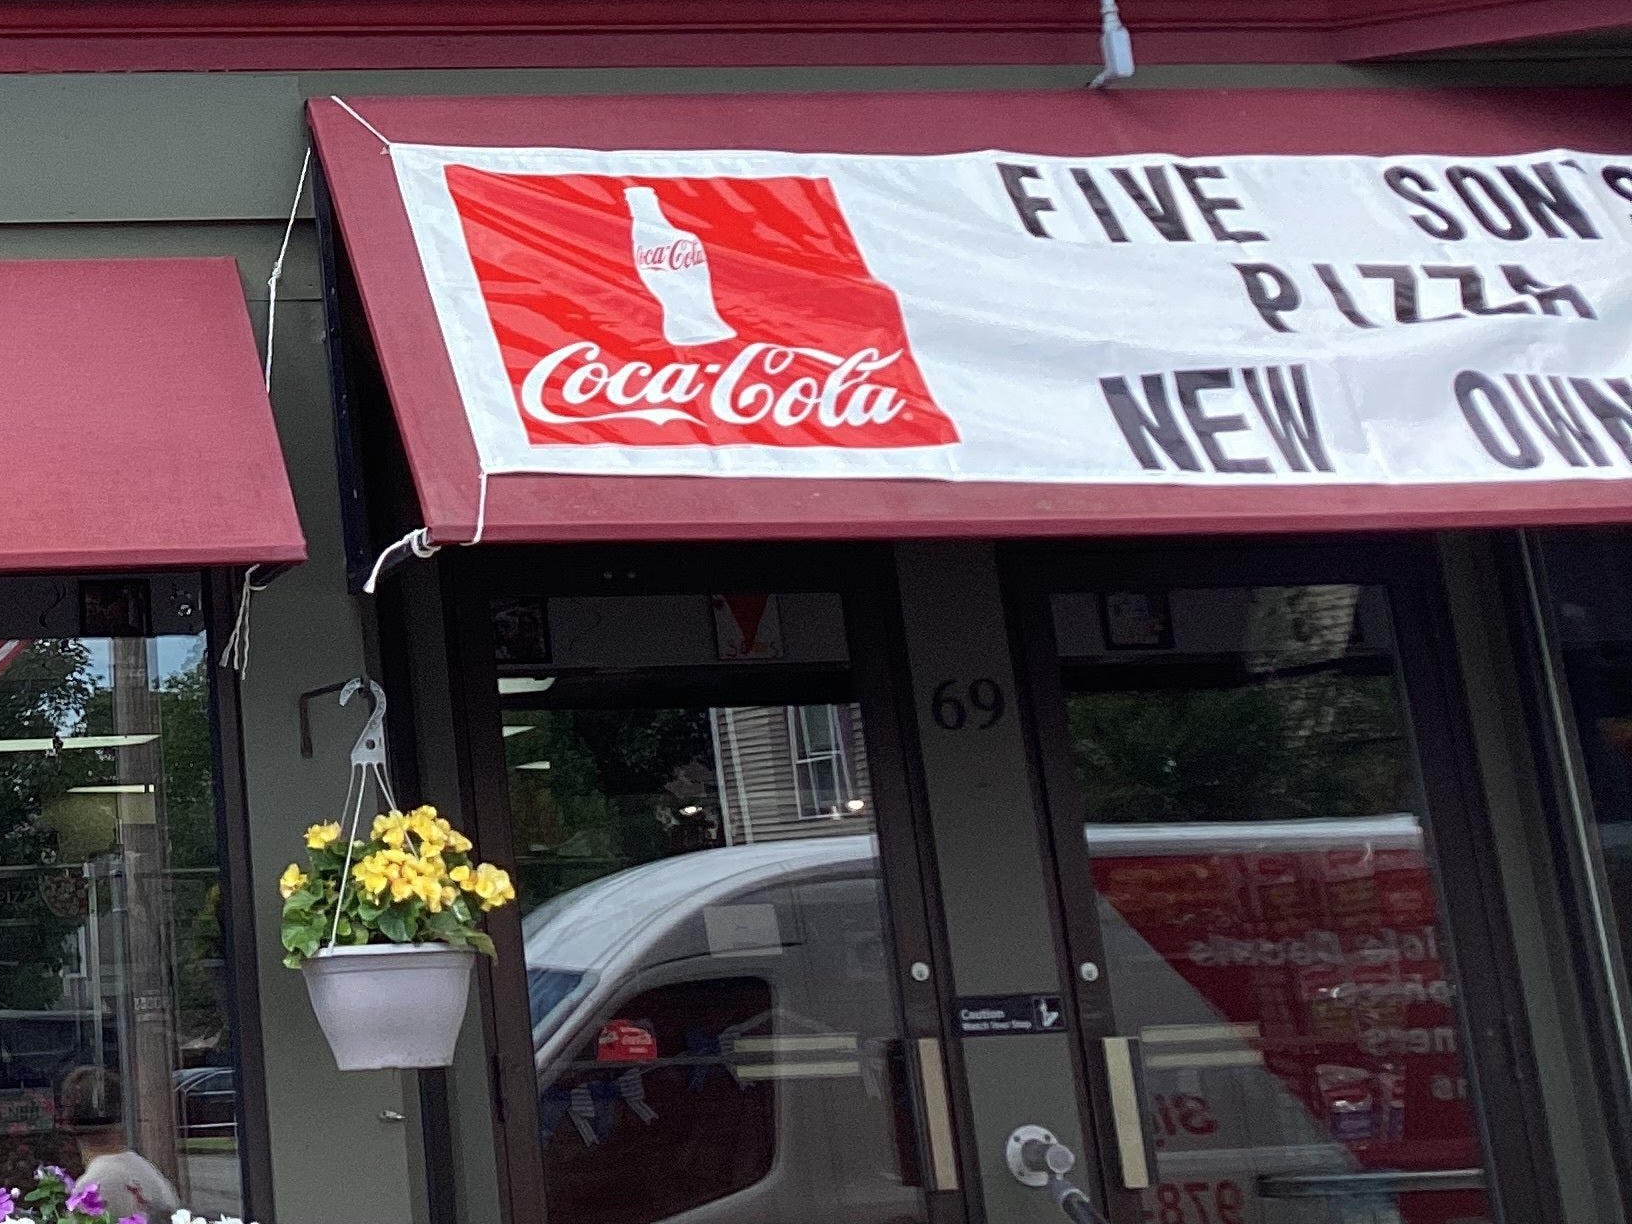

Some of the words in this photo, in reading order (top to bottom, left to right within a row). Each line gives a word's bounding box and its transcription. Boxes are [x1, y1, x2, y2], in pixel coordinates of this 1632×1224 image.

[995, 161, 1270, 243] FIVE
[1232, 262, 1599, 333] PIZZA
[521, 340, 908, 427] Coca-Cola
[1098, 363, 1337, 474] NEW
[930, 677, 1006, 731] 69
